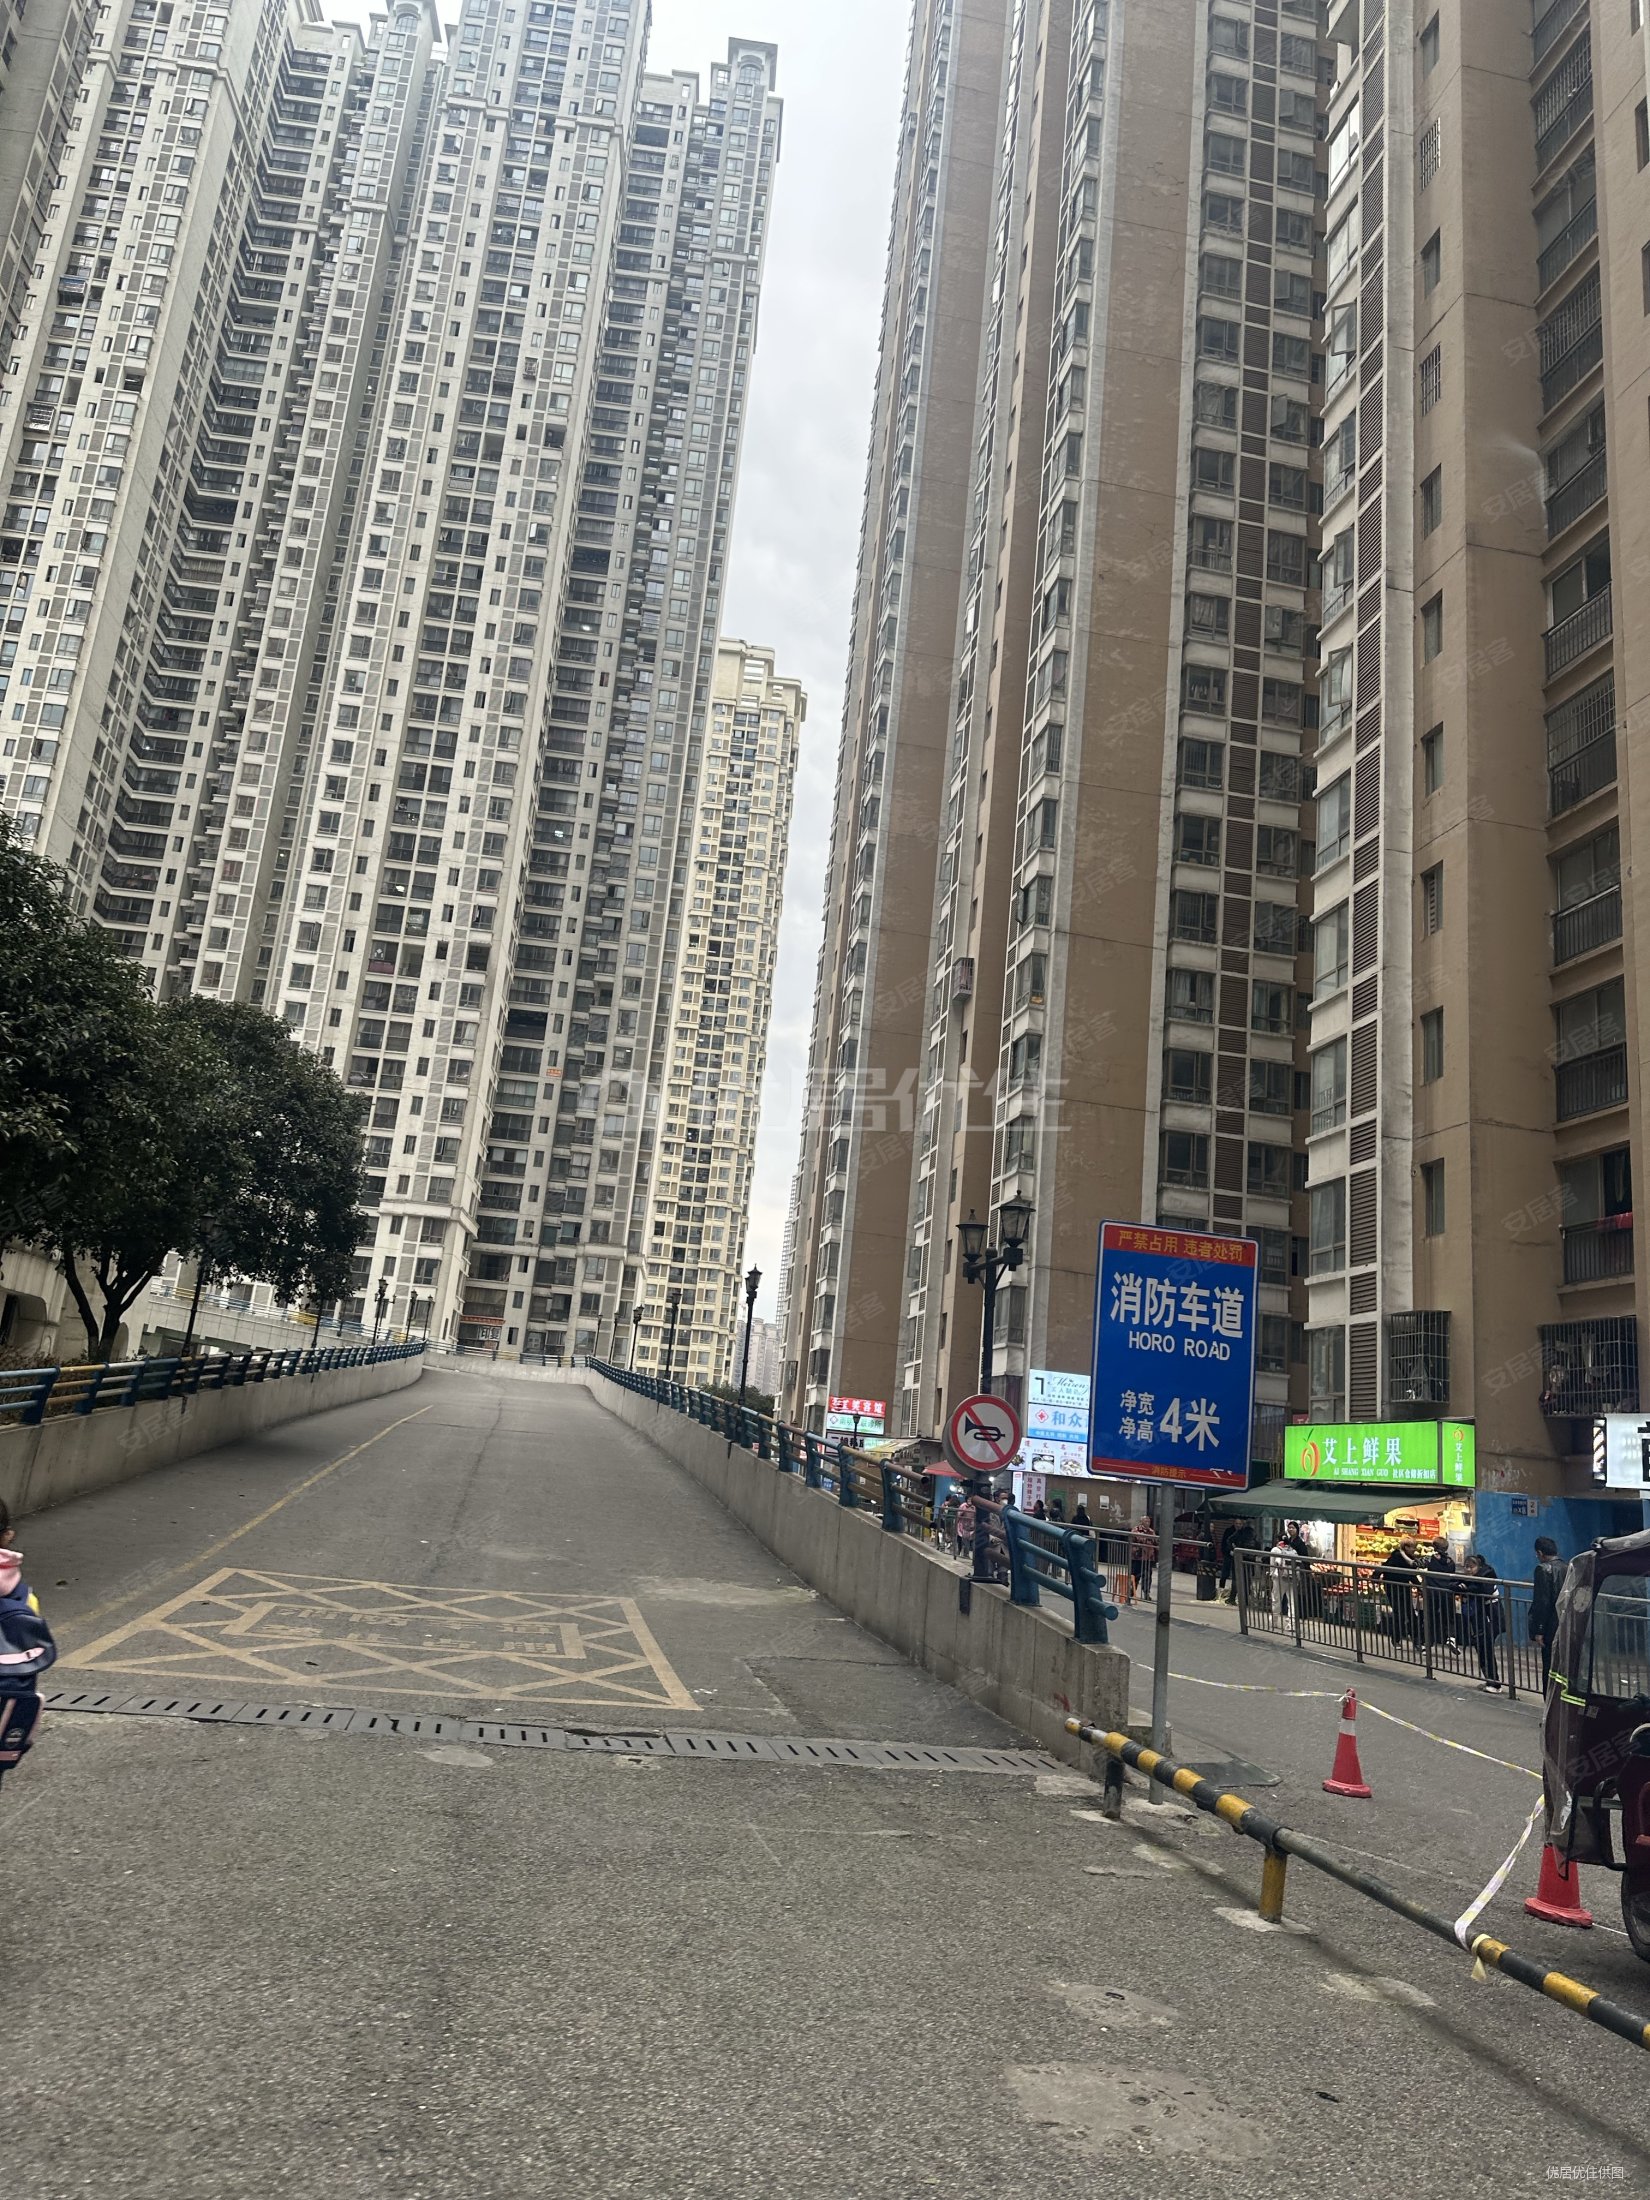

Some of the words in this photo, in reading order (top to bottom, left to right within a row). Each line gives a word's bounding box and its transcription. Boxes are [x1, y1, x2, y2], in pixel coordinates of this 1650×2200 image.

[1118, 1230, 1178, 1253] 严禁占用
[1184, 1239, 1244, 1262] 违者处罚
[1110, 1271, 1245, 1338] 消防车道
[1129, 1331, 1175, 1353] HORO
[1184, 1338, 1231, 1361] ROAD
[1120, 1389, 1155, 1416] 净宽
[1051, 1410, 1088, 1428] 和众
[1118, 1416, 1154, 1443] 净高
[1322, 1437, 1402, 1467] 艾上鲜果
[1454, 1443, 1463, 1483] 艾上鲜果
[1341, 1468, 1359, 1476] SHANG
[1361, 1468, 1374, 1476] XIAN
[1376, 1468, 1389, 1477] GUO
